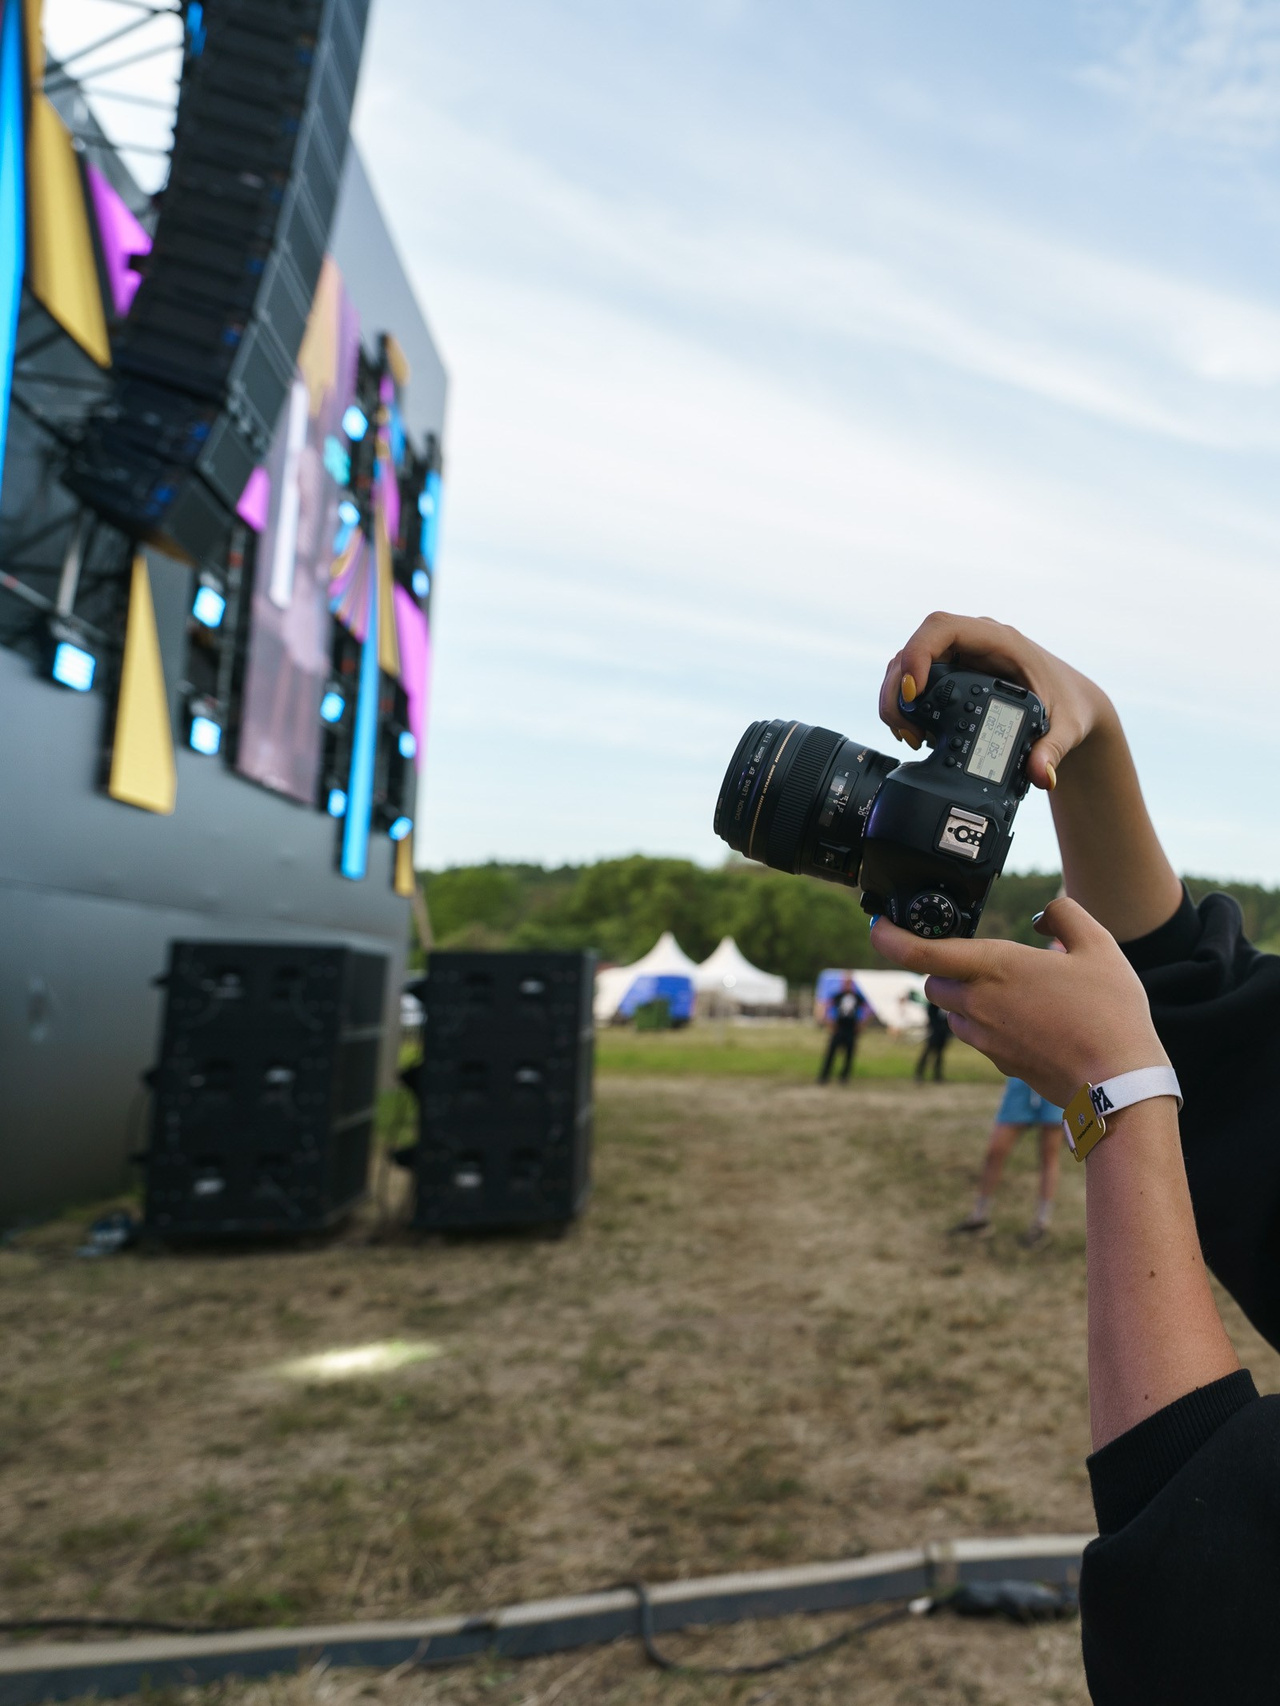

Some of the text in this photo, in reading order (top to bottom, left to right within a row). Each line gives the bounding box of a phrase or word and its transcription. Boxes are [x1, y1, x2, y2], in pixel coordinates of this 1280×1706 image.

[962, 740, 971, 754] DRIVE
[1017, 755, 1025, 770] AF-ON
[735, 800, 745, 821] CANON
[741, 779, 751, 796] LENS
[749, 766, 756, 775] EF
[754, 746, 765, 763] 85mm
[940, 902, 949, 910] Av
